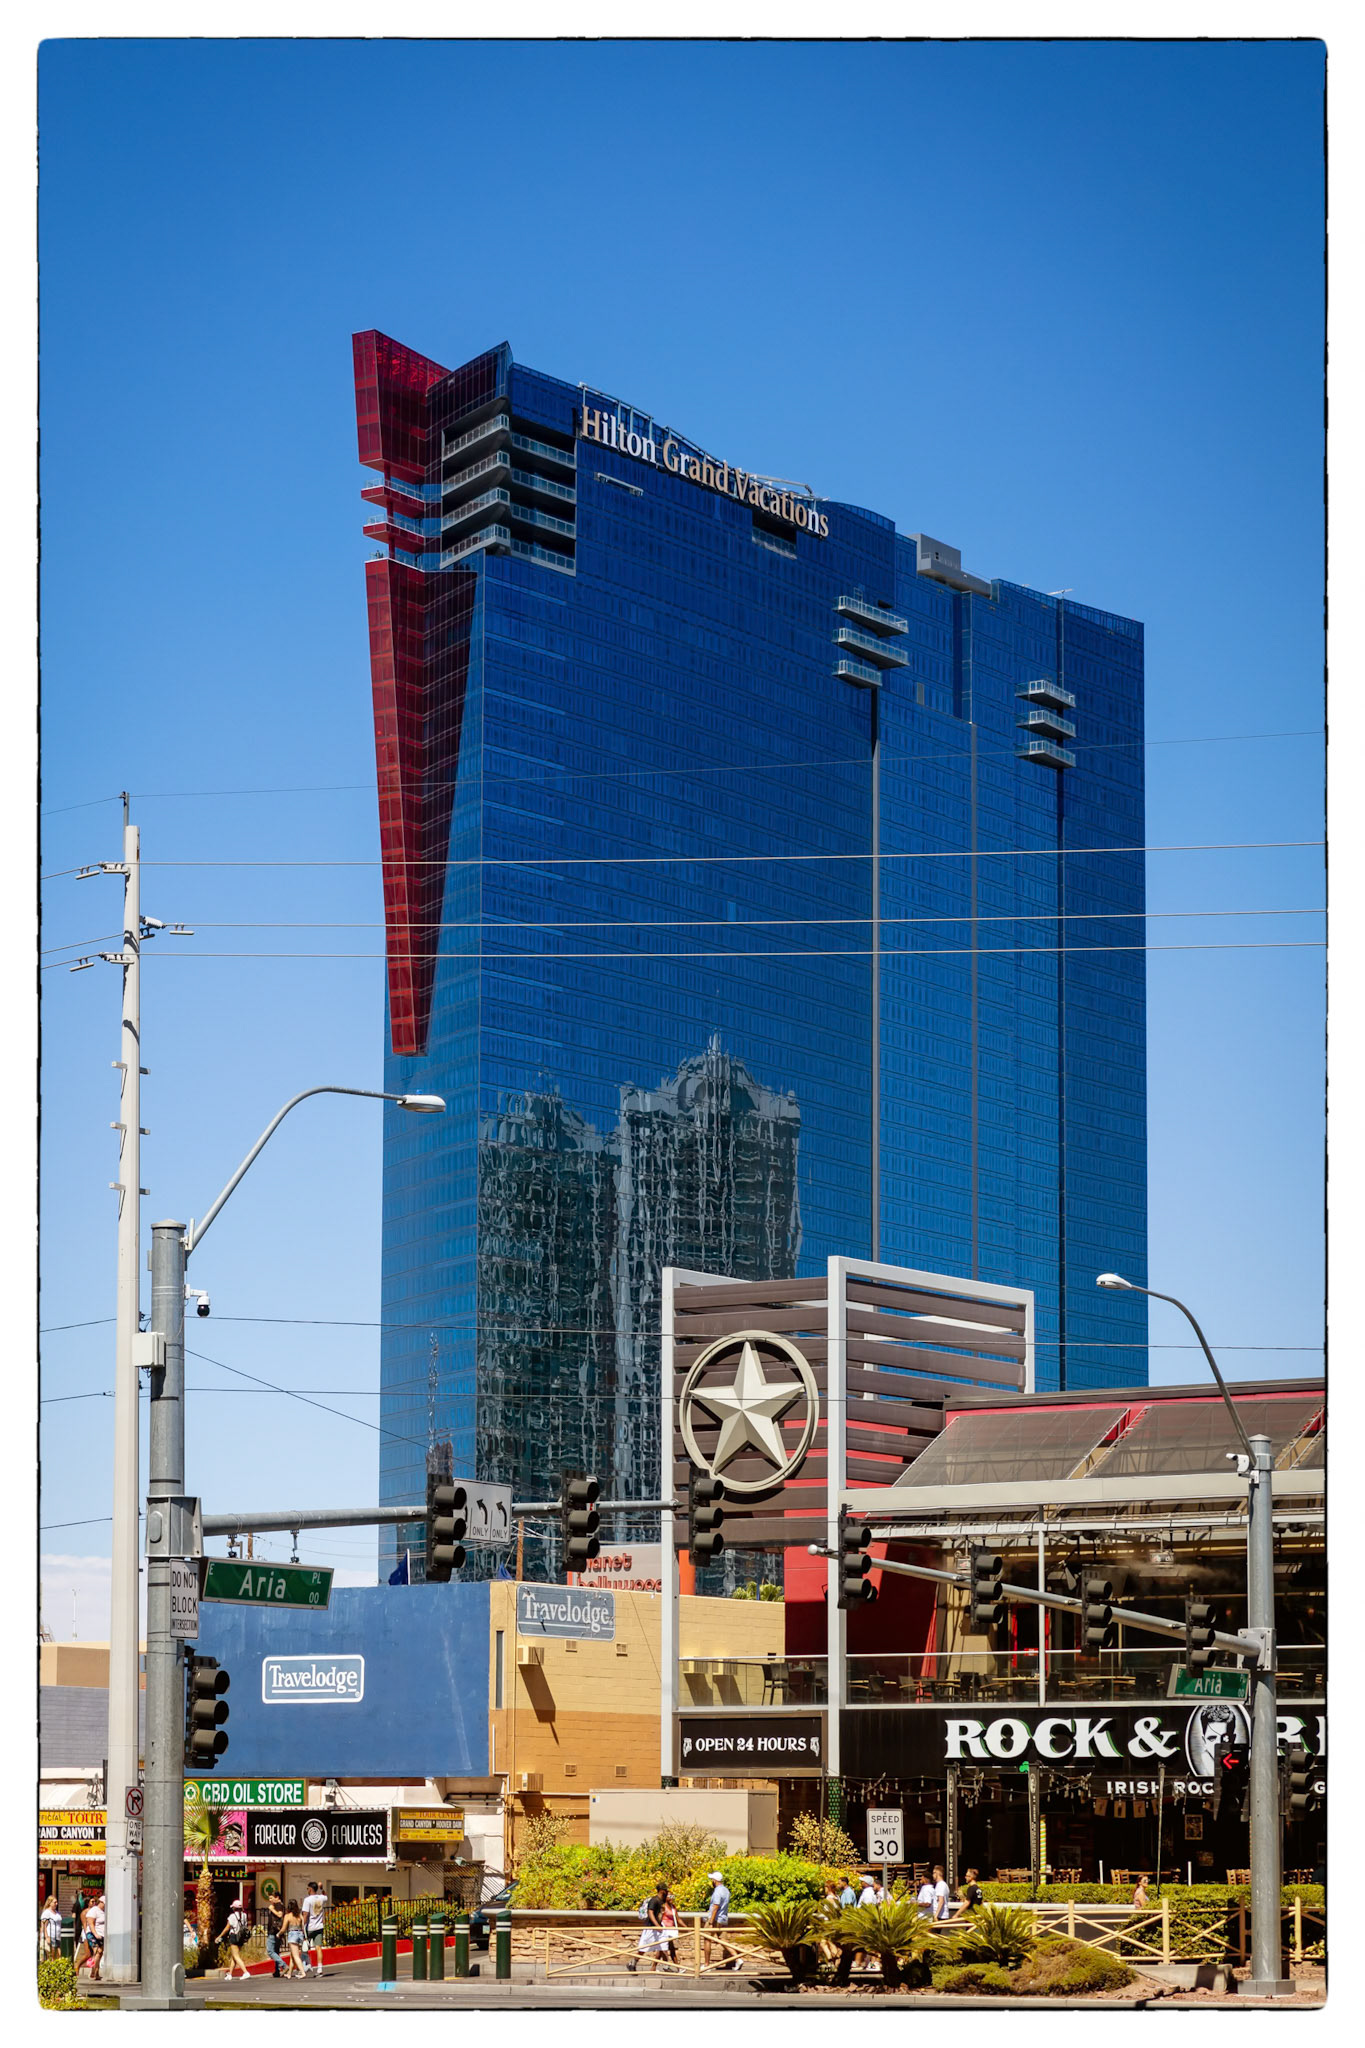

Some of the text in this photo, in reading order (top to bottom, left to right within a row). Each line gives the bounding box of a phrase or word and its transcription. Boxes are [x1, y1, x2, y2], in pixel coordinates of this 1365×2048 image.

[581, 405, 829, 537] Hilton Grand Vacations
[472, 1526, 508, 1539] ONLY ONLY
[172, 1570, 197, 1589] DO NOT
[208, 1563, 321, 1599] E Aria PL
[171, 1595, 198, 1614] BLOCK
[308, 1592, 320, 1604] 00
[521, 1591, 609, 1633] Travelodge
[268, 1663, 358, 1694] Travelodge
[1194, 1673, 1222, 1694] Aria
[695, 1737, 807, 1751] OPEN 24 HOURS
[944, 1715, 1325, 1758] ROCK & R
[202, 1783, 303, 1804] CBD OIL STORE
[1173, 1781, 1215, 1795] ROC
[67, 1812, 105, 1824] TOUR
[129, 1821, 142, 1830] ONE
[871, 1815, 900, 1823] SPEED
[39, 1827, 95, 1839] AND CANYON
[128, 1830, 141, 1838] WAY
[254, 1824, 296, 1845] FOREVER
[331, 1824, 383, 1845] FLAWLESS
[873, 1828, 897, 1836] LIMIT
[873, 1840, 899, 1856] 30
